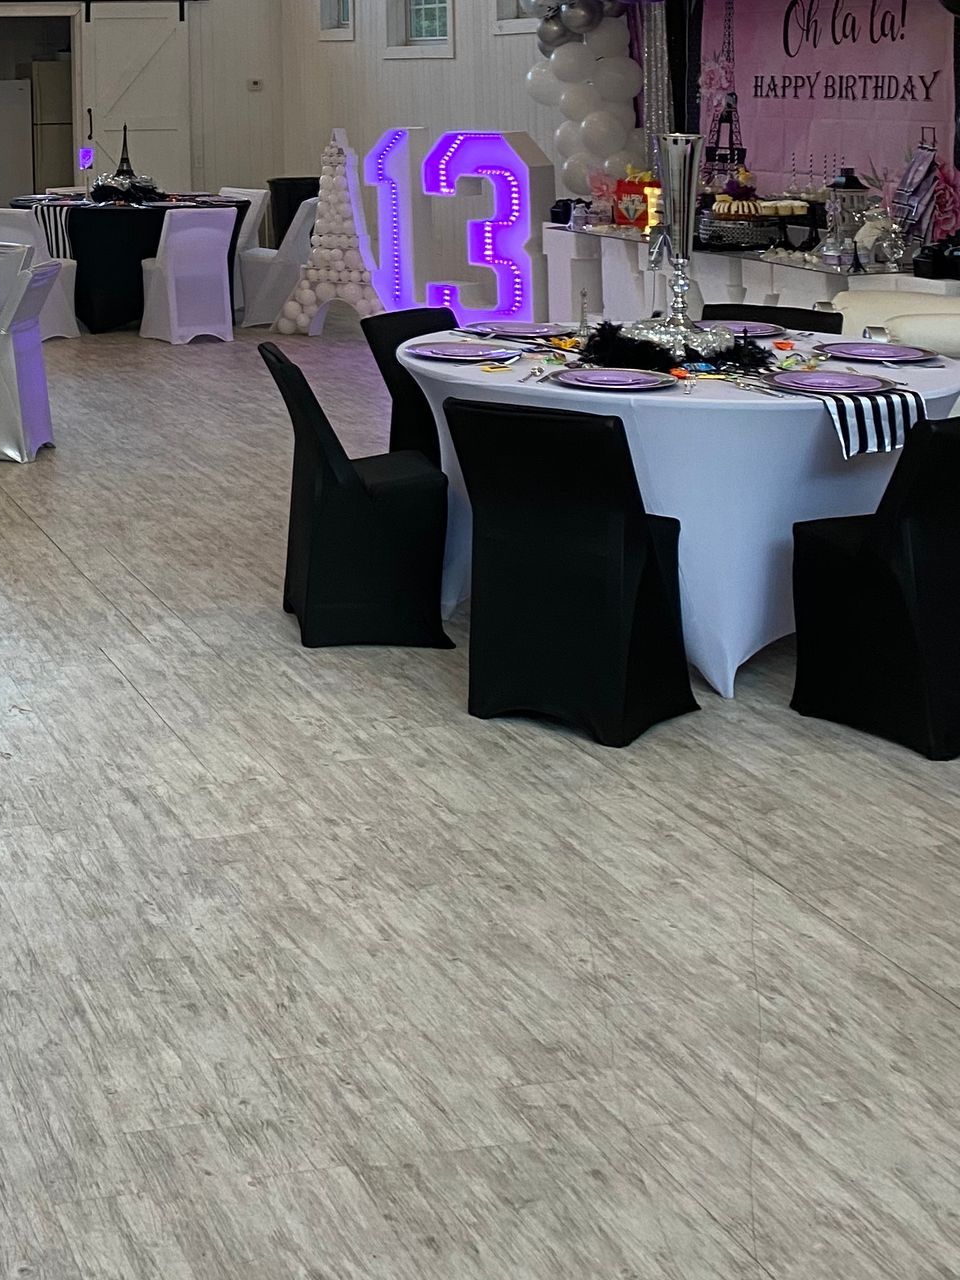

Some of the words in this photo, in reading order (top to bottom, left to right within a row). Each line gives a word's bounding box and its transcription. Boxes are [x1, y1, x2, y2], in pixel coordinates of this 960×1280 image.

[753, 70, 822, 99] HAPPY
[823, 70, 942, 101] BIRTHDAY
[364, 127, 536, 324] 13
